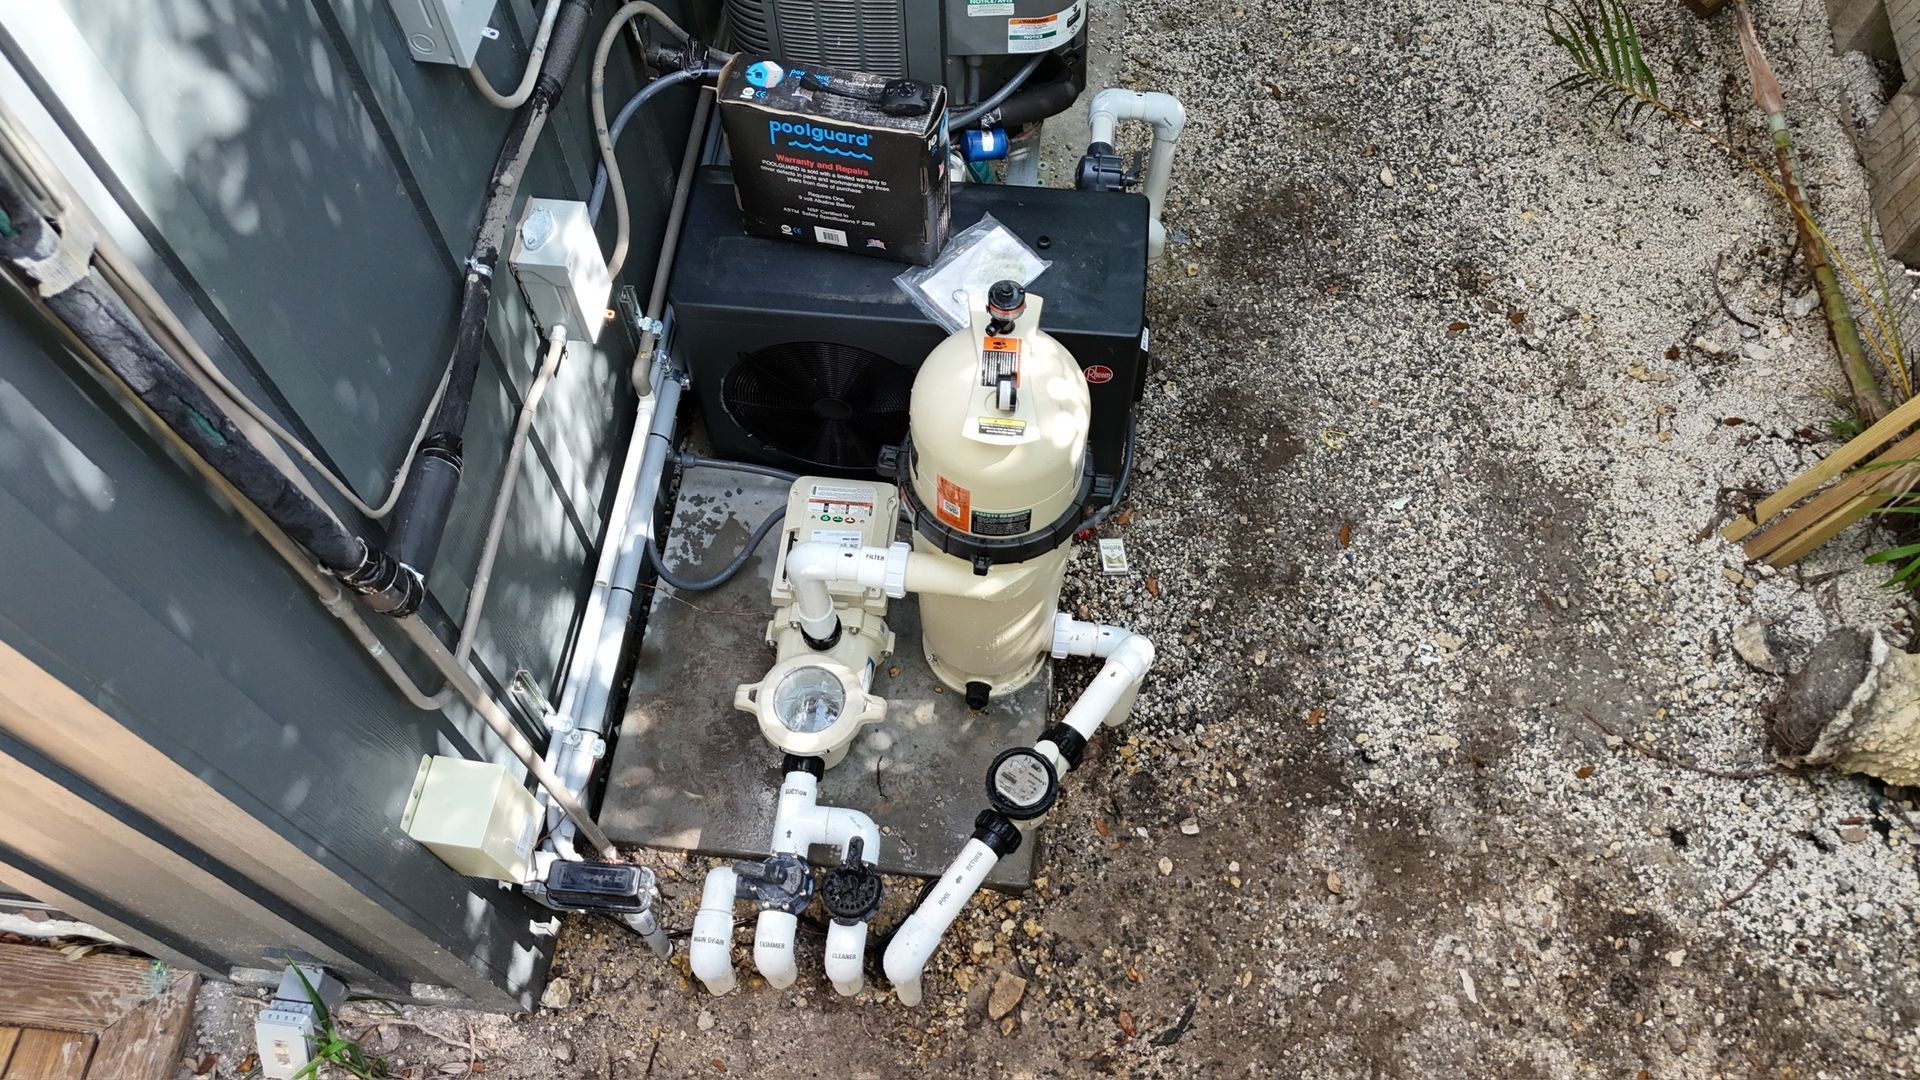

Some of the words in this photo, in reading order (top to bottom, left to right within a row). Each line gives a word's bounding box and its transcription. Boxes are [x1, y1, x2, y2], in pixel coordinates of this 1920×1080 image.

[788, 69, 832, 83] pooard
[769, 120, 868, 147] poolguard
[775, 154, 815, 169] Warranty
[816, 161, 833, 171] and
[835, 164, 869, 177] Repairs
[761, 160, 800, 172] POOLGUARD
[837, 174, 855, 182] limited
[855, 177, 880, 186] warranty
[776, 169, 796, 177] defects
[829, 179, 865, 190] workmanship
[807, 192, 832, 200] Requires
[819, 215, 856, 225] Specifications
[820, 210, 843, 218] Certified
[1087, 366, 1111, 380] Rheem
[865, 553, 885, 561] FILTER
[784, 788, 807, 797] SUCTION
[965, 851, 984, 872] RETURN
[938, 891, 952, 906] POOL
[707, 937, 725, 945] DRAIN
[759, 941, 786, 949] SKIMMER
[831, 952, 857, 960] CLEANER
